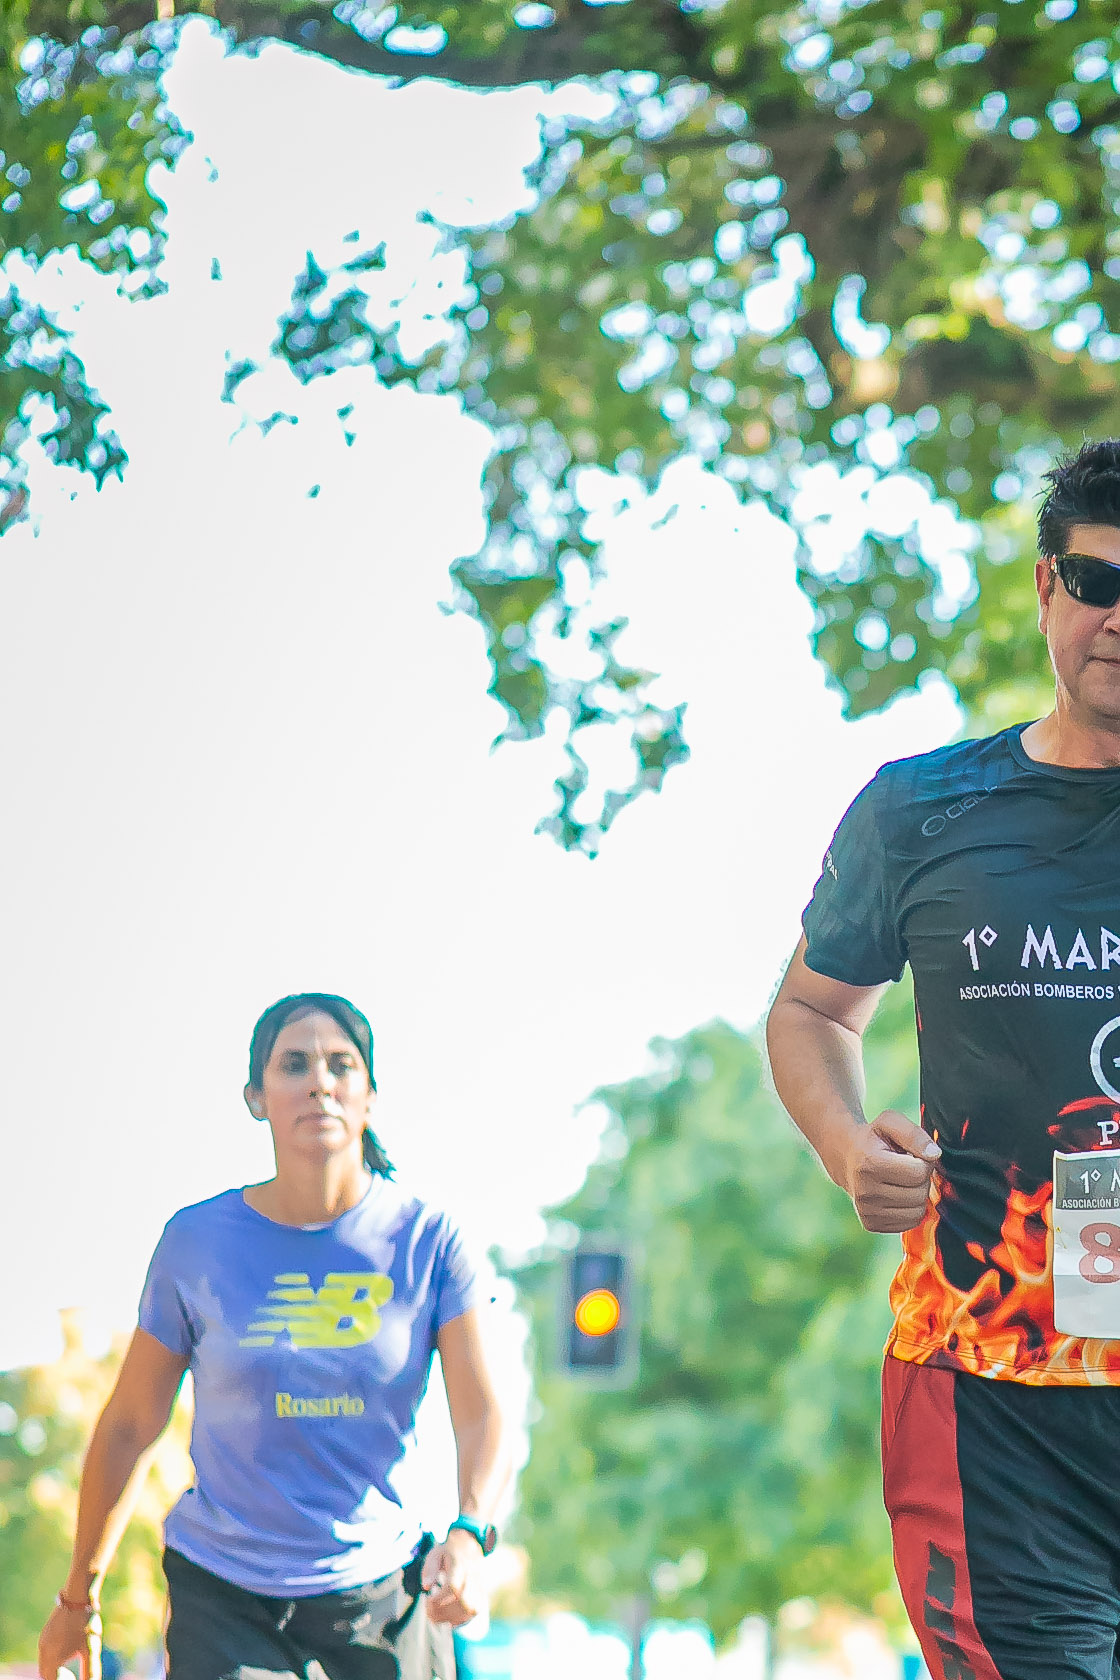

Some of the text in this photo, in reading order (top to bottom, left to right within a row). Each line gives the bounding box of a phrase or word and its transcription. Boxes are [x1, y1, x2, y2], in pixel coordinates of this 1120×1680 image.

[959, 980, 1031, 1000] ASOCIACIÓN
[1034, 983, 1115, 1000] BOMBEROS
[1062, 1197, 1112, 1209] ASOCIACIÓN
[276, 1391, 365, 1417] Rosario
